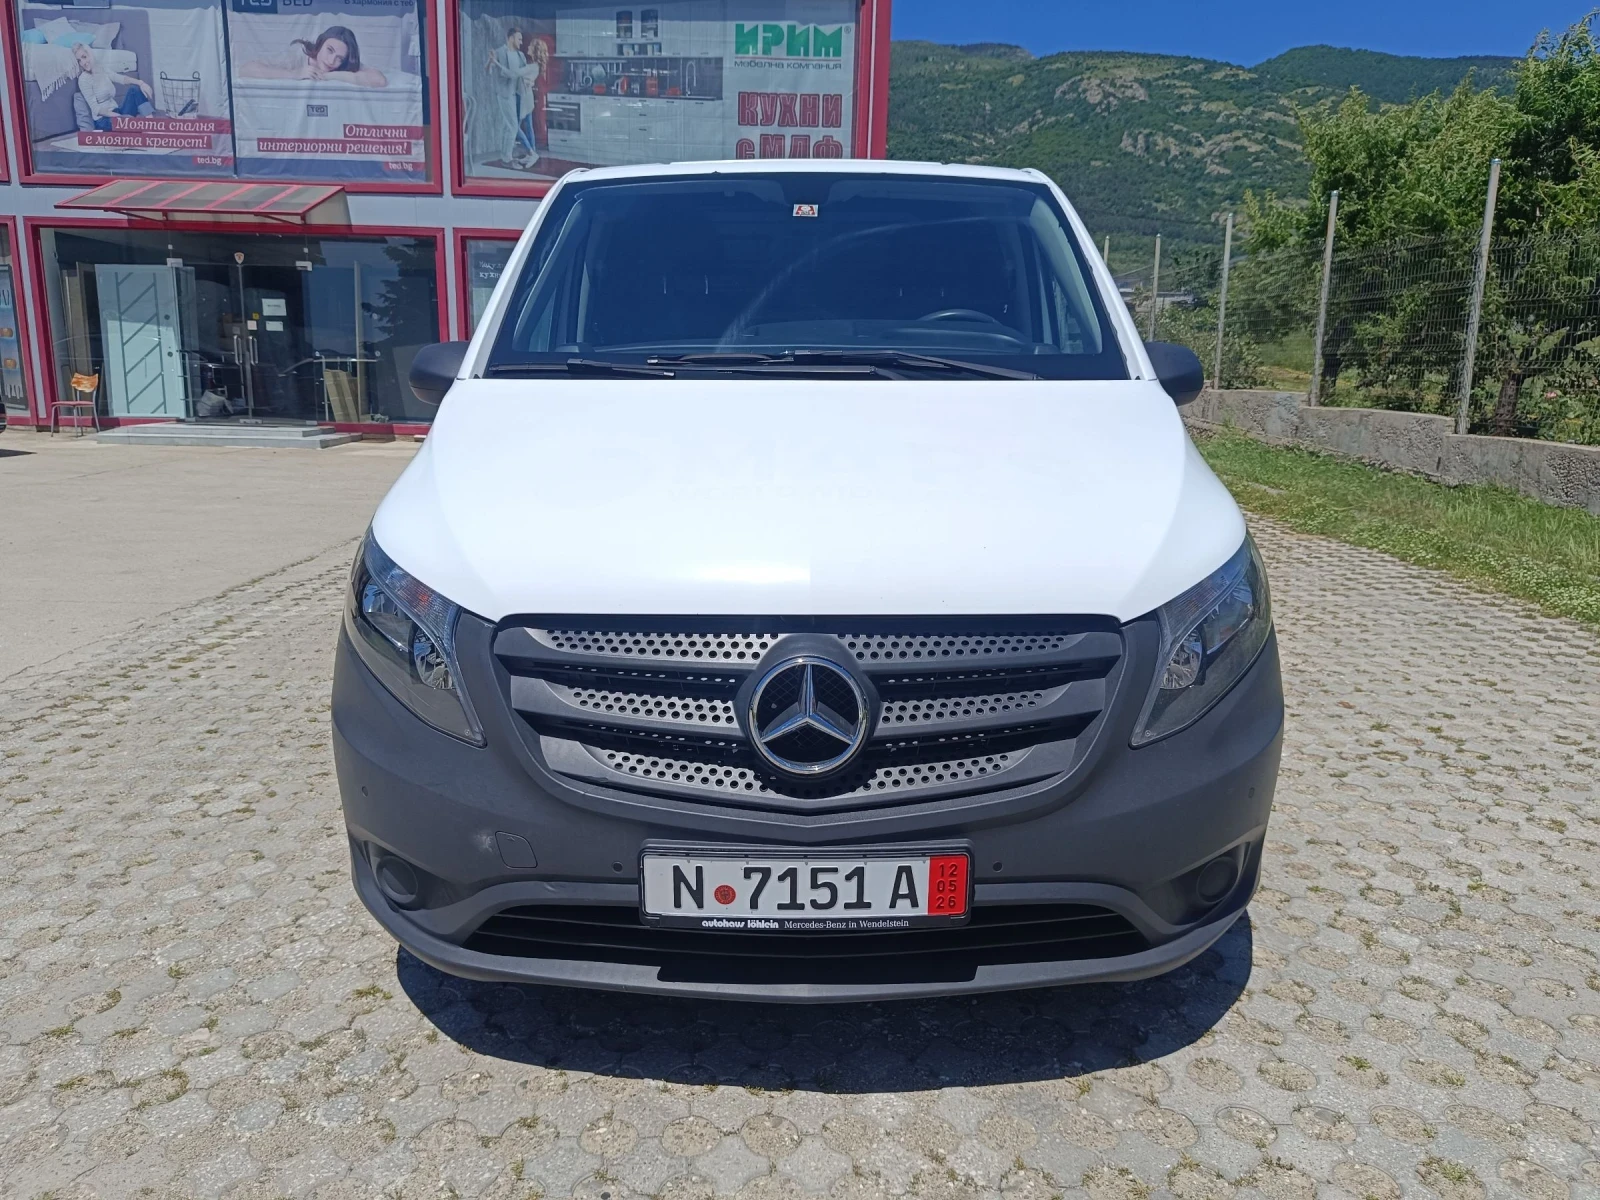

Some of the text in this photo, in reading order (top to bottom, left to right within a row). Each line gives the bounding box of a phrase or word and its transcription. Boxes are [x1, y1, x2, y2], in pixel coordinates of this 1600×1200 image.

[735, 24, 842, 58] ИРИМ
[786, 62, 842, 70] компания
[738, 91, 842, 128] КУХНИ
[115, 117, 215, 132] Моята спалня
[345, 124, 407, 138] Отлични
[85, 135, 208, 149] е моята крепост!
[259, 140, 407, 155] интериорни решения!
[197, 156, 222, 166] ted.bg
[938, 863, 958, 877] 12
[672, 865, 704, 909] N
[743, 866, 872, 910] 7151
[888, 864, 919, 909] A
[936, 879, 957, 892] 05
[936, 895, 957, 909] 26
[701, 919, 909, 929] autohaus löhlein Mercedes-Benz in Wendelstein
